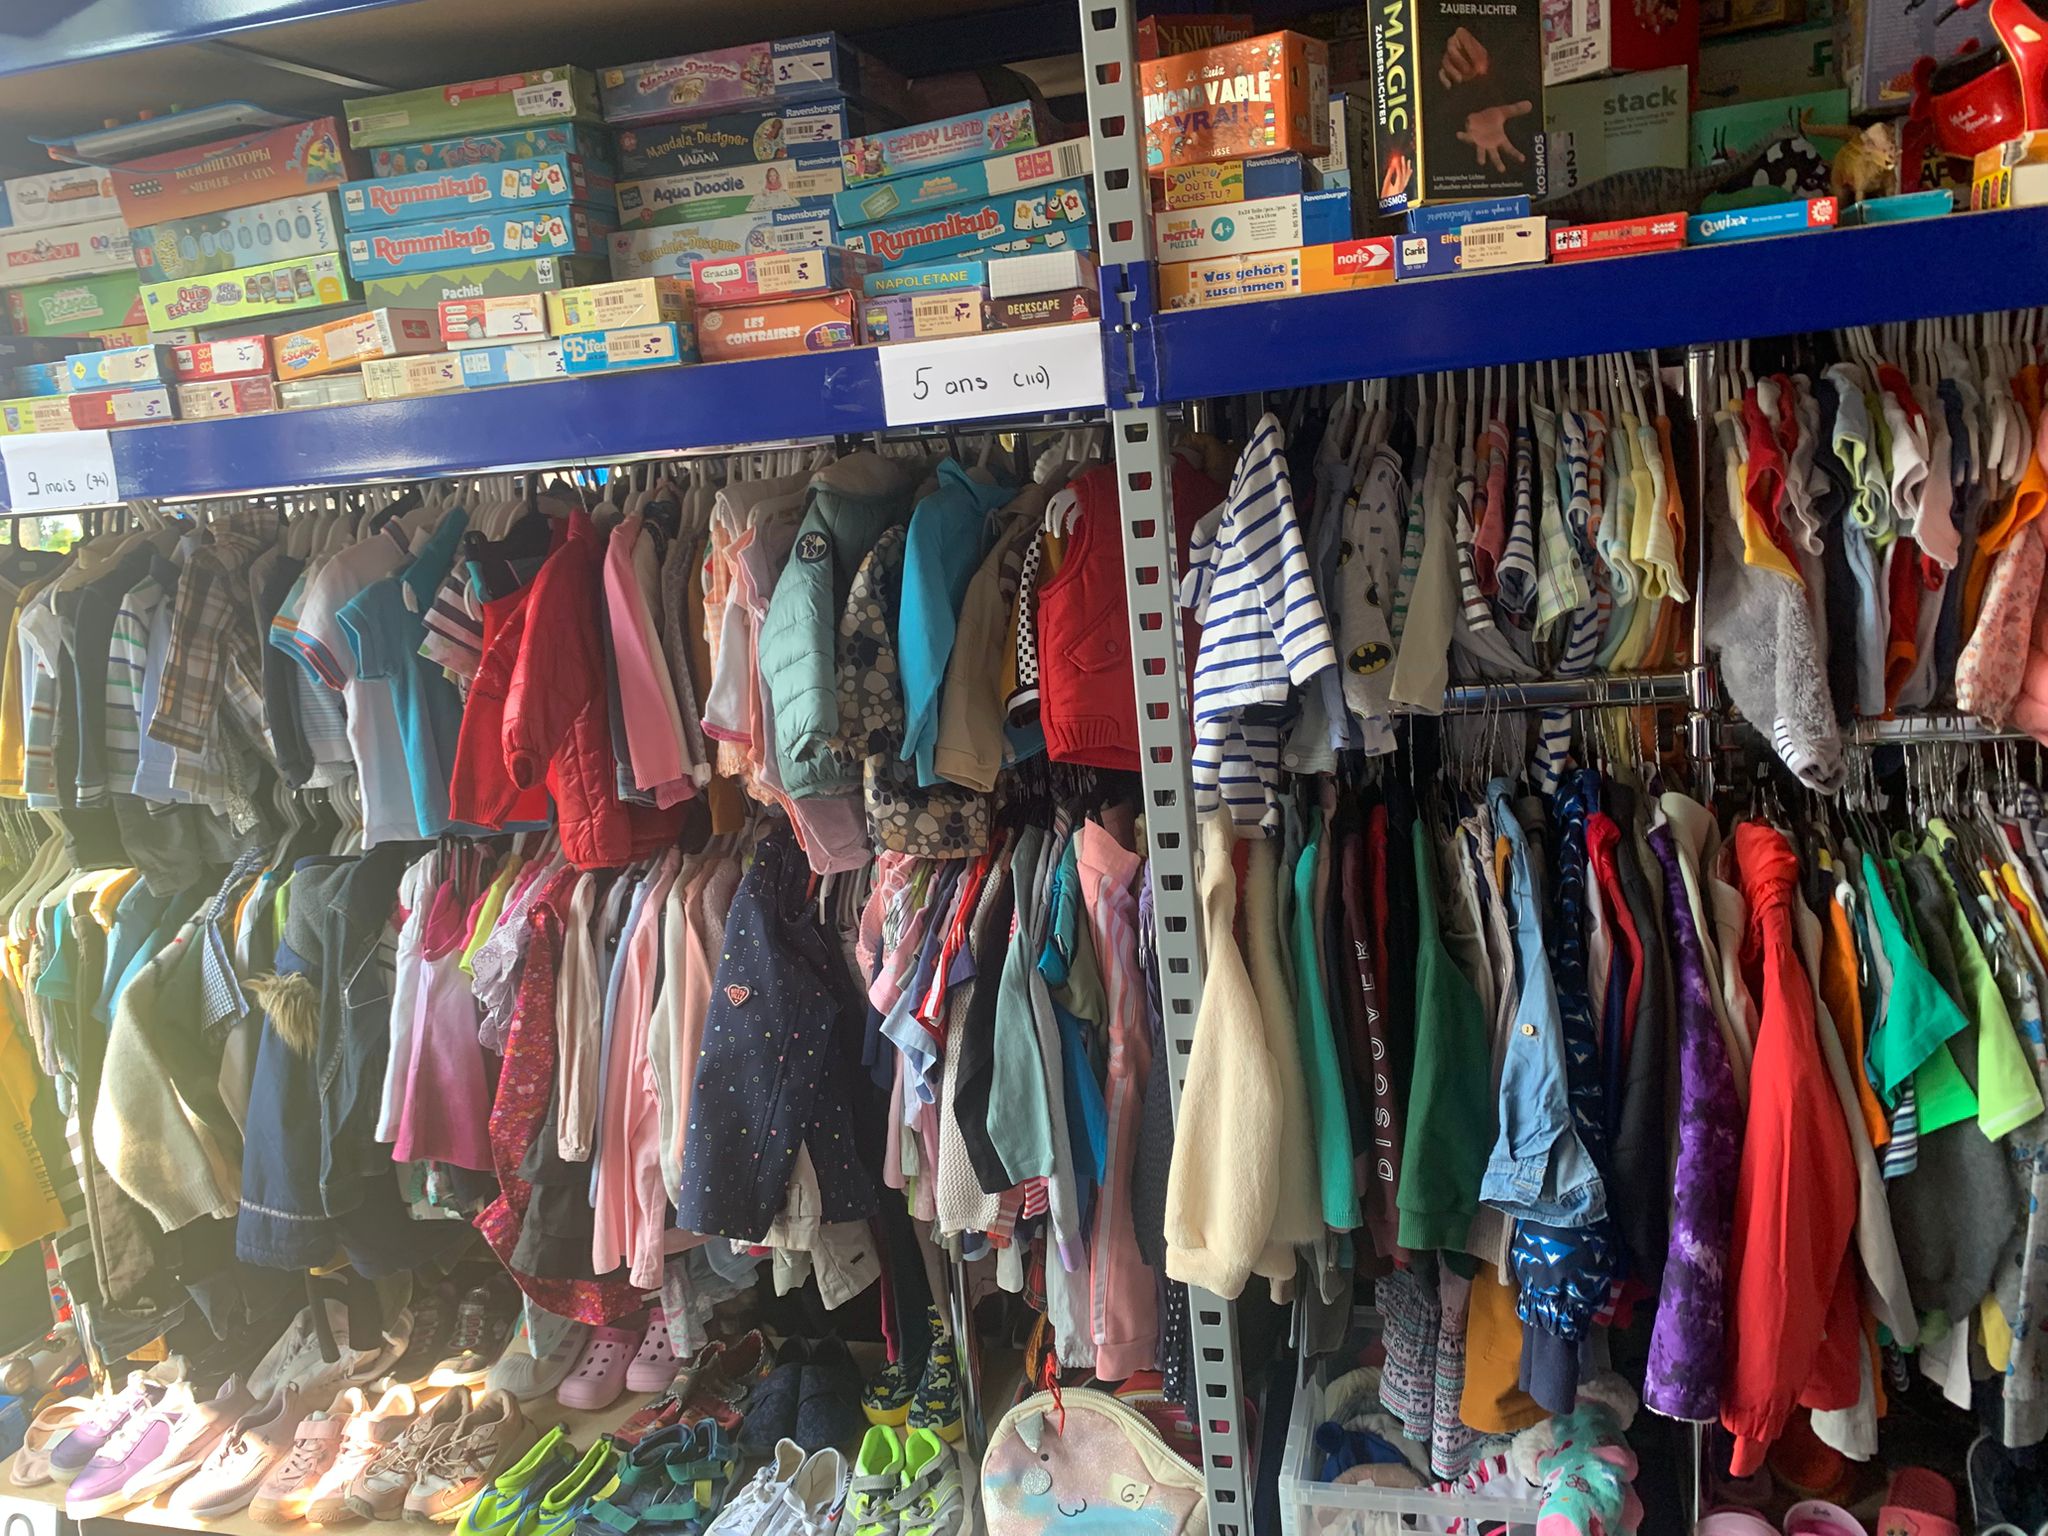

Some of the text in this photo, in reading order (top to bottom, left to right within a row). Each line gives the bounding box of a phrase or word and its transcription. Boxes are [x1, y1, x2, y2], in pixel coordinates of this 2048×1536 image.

[1440, 3, 1517, 15] ZAUBER-LICHTER
[774, 36, 831, 52] Ravensburger
[1375, 24, 1387, 125] ZAUBER-LICHTER
[1383, 1, 1408, 135] MAGIC
[1603, 85, 1678, 116] stack
[786, 103, 841, 118] Ravensburger
[887, 118, 984, 153] CANDY LAND
[646, 131, 748, 159] Mandala-Designer
[799, 157, 841, 167] Ravensburger
[1246, 153, 1300, 168] Ravensburger
[1535, 134, 1547, 195] KOSMOS
[369, 173, 487, 215] Rummikub
[653, 177, 745, 203] Aqua Doodle
[1303, 190, 1348, 202] Ravensburger
[1380, 193, 1408, 208] KOSMOS
[776, 207, 831, 222] Ravensburger
[871, 208, 999, 259] Rummikub
[1214, 222, 1231, 236] 4+
[1700, 213, 1749, 237] Qwixx
[374, 225, 491, 264] Rummikub
[1337, 248, 1370, 266] noris
[703, 268, 740, 279] Gracias
[875, 270, 968, 290] NAPOLETANE
[1204, 263, 1285, 283] Was gehört
[442, 284, 484, 300] Pachisi
[1206, 280, 1285, 298] zusammen
[1007, 299, 1060, 316] DECKSCAPE
[743, 316, 765, 329] LES
[100, 332, 133, 350] Risk
[726, 326, 801, 345] CONTRAIRES
[913, 367, 933, 400] 5
[945, 374, 988, 395] ans
[27, 471, 40, 496] 9
[45, 478, 76, 495] mois
